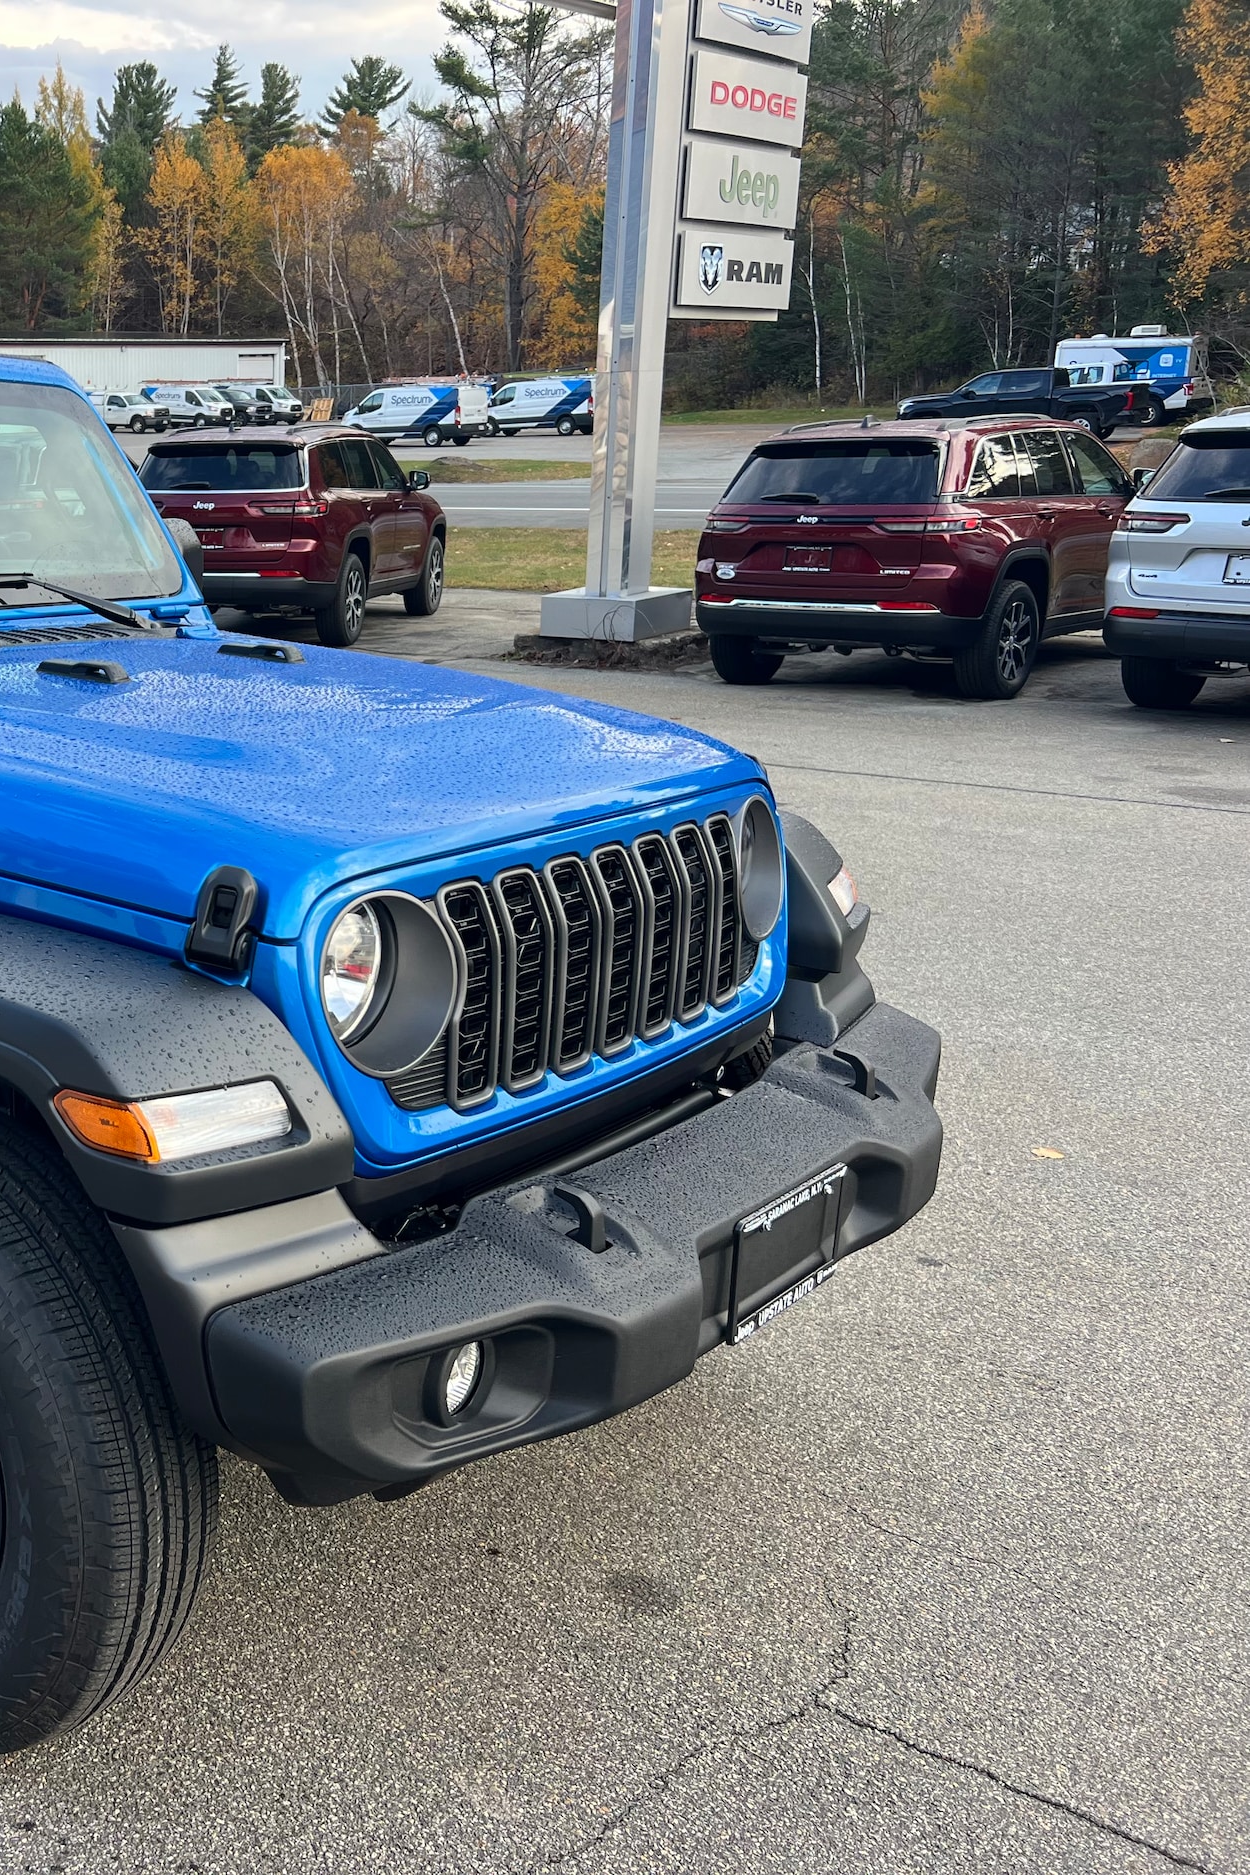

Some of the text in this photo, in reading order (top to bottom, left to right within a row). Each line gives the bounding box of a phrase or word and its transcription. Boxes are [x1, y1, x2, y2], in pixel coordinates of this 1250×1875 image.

[710, 80, 798, 120] DODGE
[719, 154, 779, 218] Jeep
[726, 259, 784, 285] RAM
[154, 391, 180, 399] Spectrum
[390, 395, 431, 406] Spectrum
[524, 383, 564, 398] Spectrum
[192, 501, 215, 511] Jeep
[796, 514, 819, 524] Jeep
[768, 1197, 796, 1223] SARANAC
[794, 1188, 811, 1207] LAKE,
[734, 1277, 815, 1343] Jeep UPSTATE AUTO
